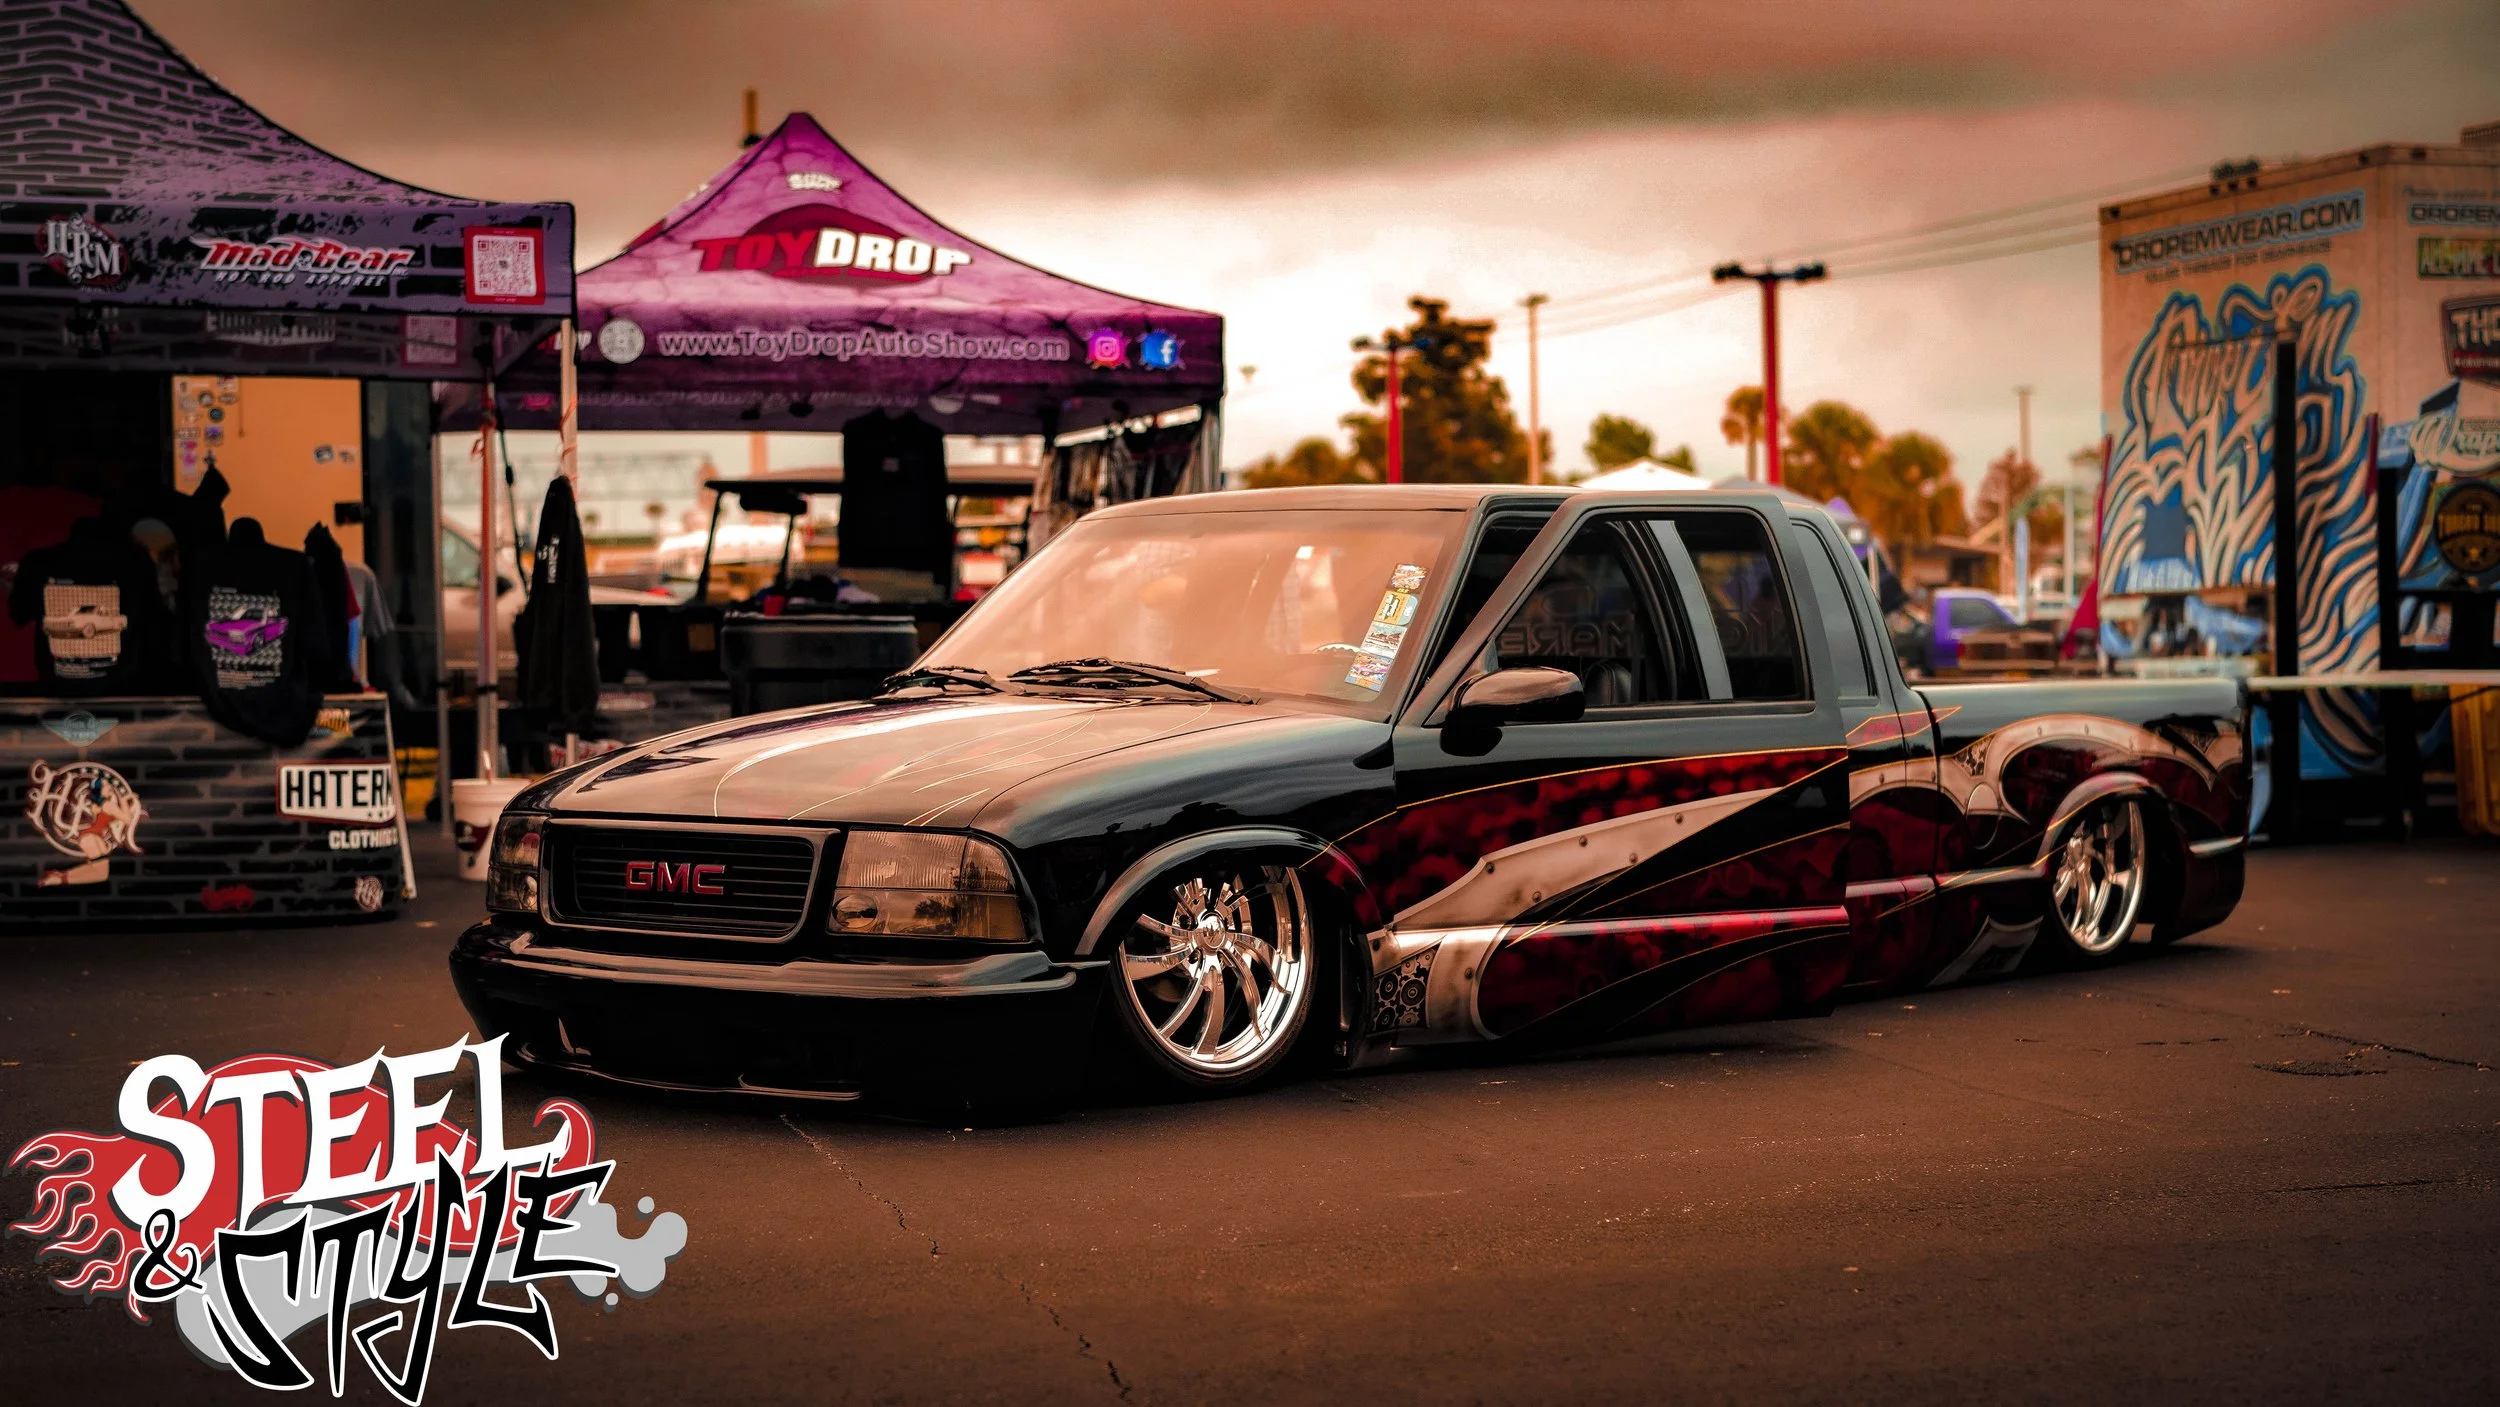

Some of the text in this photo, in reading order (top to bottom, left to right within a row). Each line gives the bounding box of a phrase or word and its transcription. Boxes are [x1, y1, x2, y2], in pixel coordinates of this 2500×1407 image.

[43, 213, 122, 284] HRM
[692, 226, 974, 276] TOYDROP
[2117, 196, 2363, 266] DROPEMWEAR.COM
[214, 270, 386, 288] HOT ROD APPAREL
[657, 326, 1071, 362] www.ToyDropAutoShow.com
[625, 861, 726, 895] GMC
